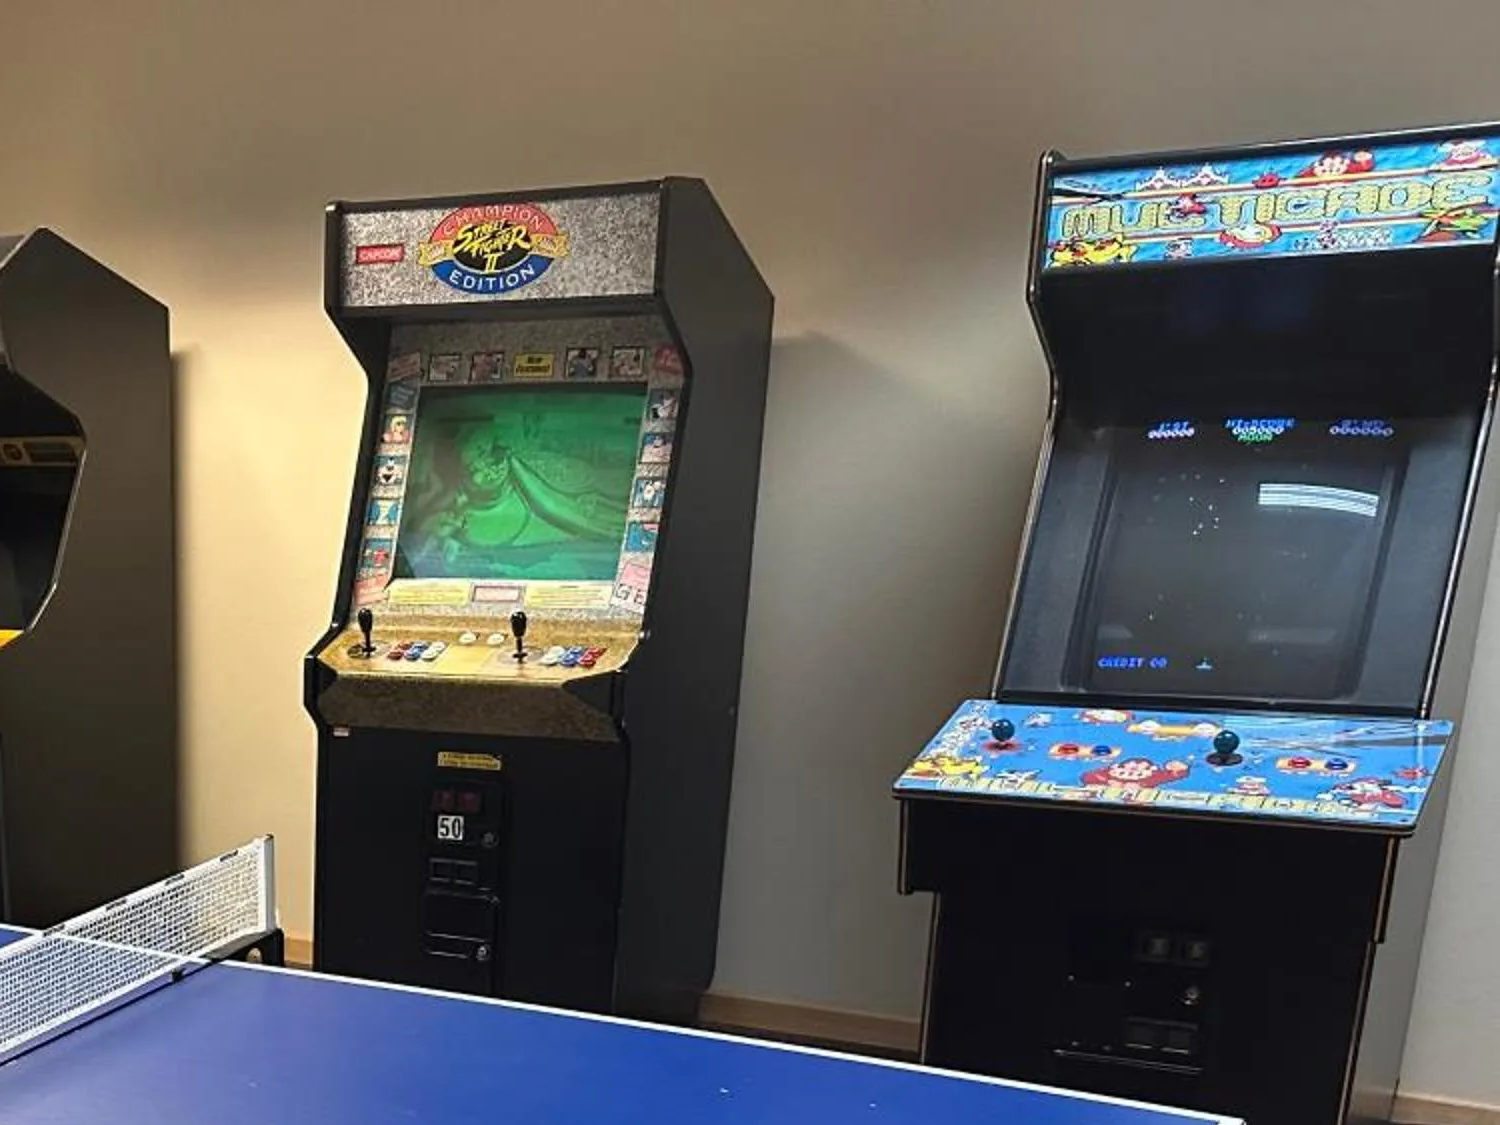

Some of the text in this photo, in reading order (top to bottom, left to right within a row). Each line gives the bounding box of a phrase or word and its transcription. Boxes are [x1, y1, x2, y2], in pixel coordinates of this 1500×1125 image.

[443, 205, 543, 235] CHAMPION
[358, 249, 400, 262] CAPCOM
[449, 264, 535, 290] EDITION
[439, 817, 461, 839] 50
